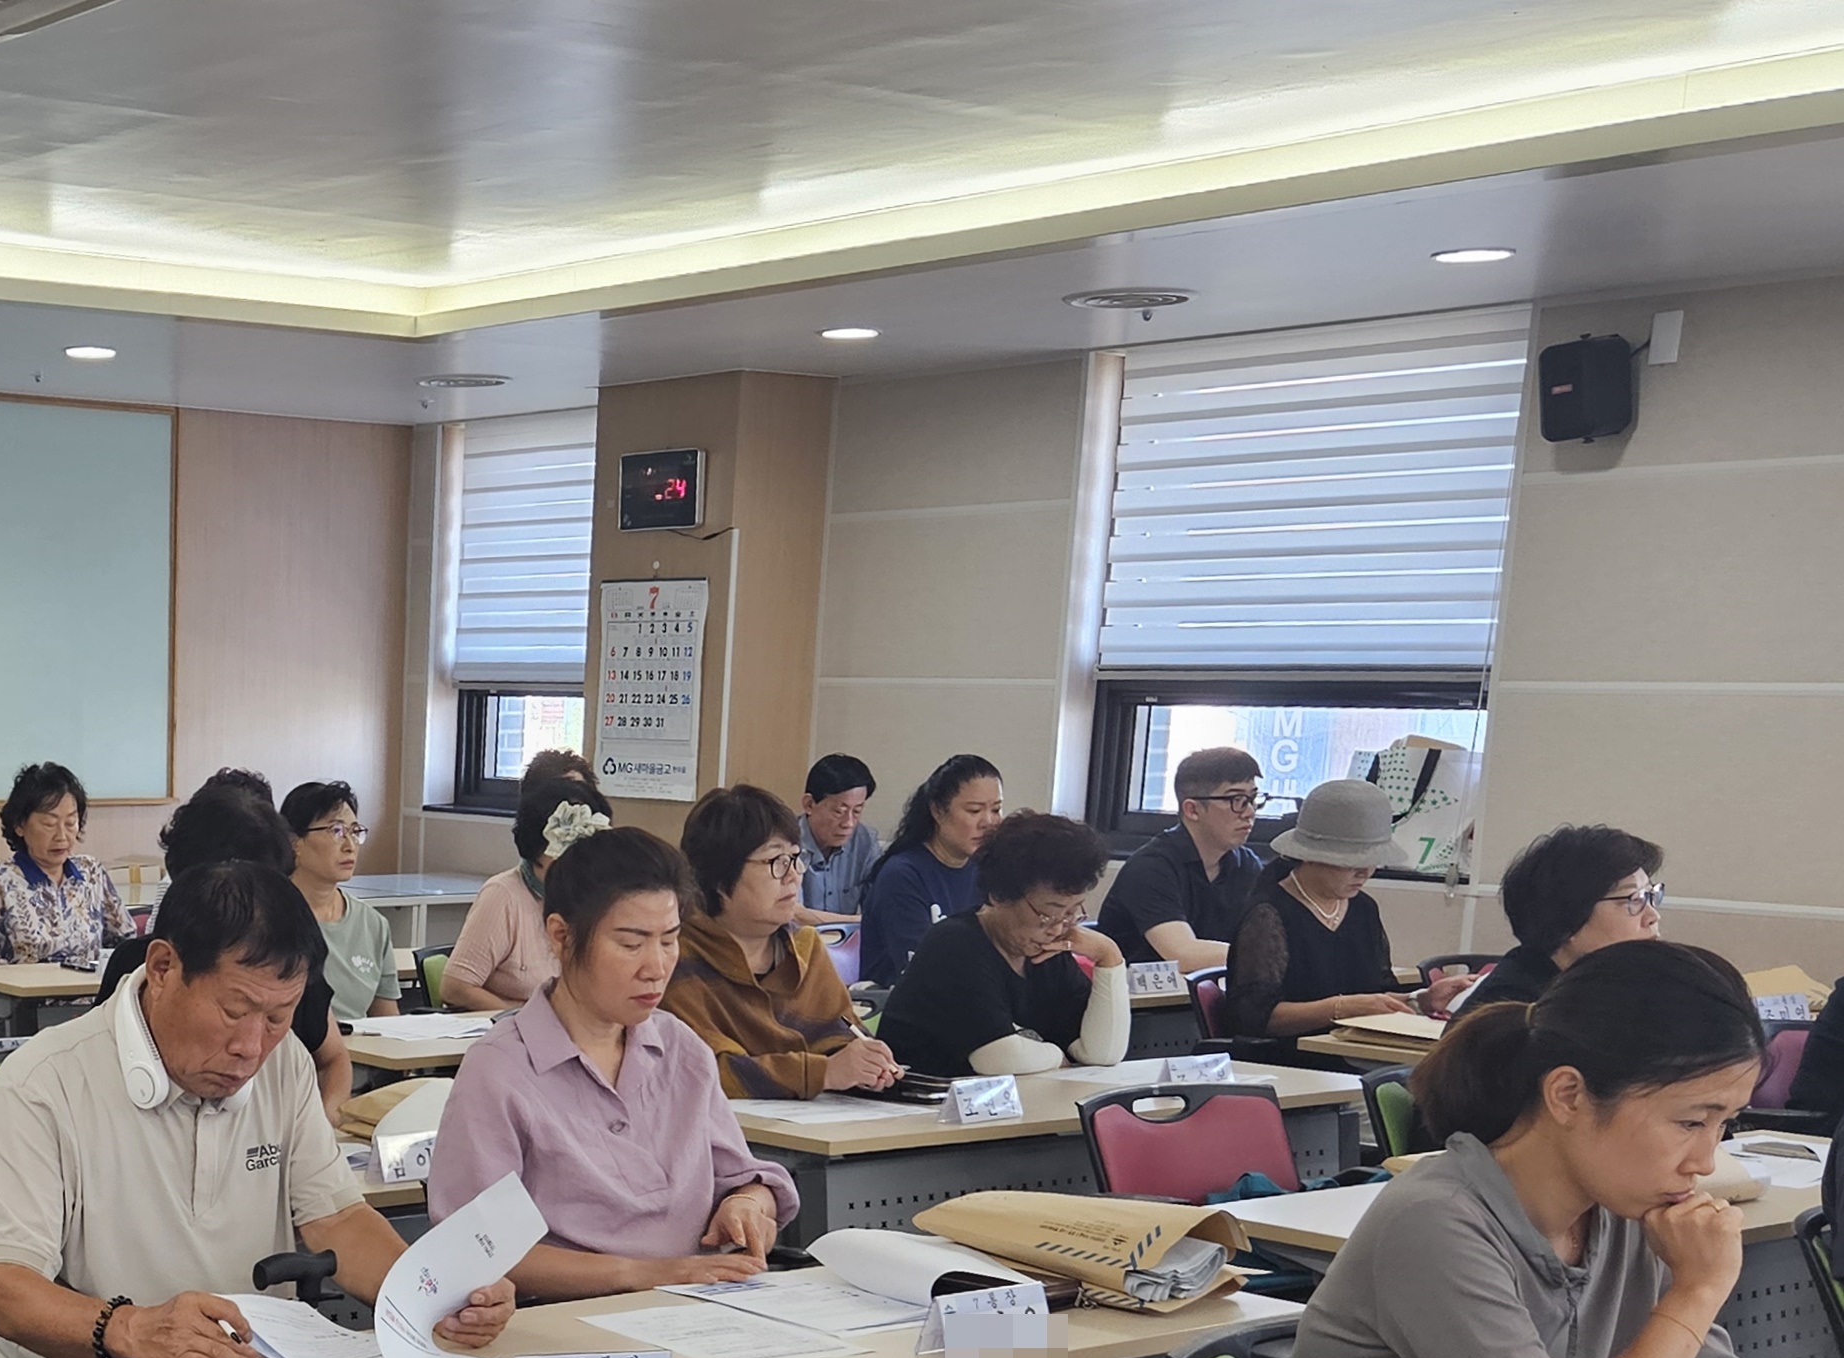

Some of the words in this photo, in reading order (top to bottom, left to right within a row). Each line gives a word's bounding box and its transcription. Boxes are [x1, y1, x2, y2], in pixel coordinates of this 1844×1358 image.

[649, 586, 660, 610] 7
[650, 623, 655, 634] 2
[662, 623, 667, 633] 3
[674, 623, 679, 633] 4
[687, 622, 693, 633] 5
[610, 647, 616, 657] 6
[623, 647, 629, 657] 7
[636, 647, 641, 657] 8
[648, 647, 654, 657] 9
[659, 647, 668, 657] 10
[672, 647, 680, 657] 11
[684, 646, 693, 657] 12
[607, 670, 616, 680] 13
[620, 670, 629, 680] 14
[633, 670, 642, 680] 15
[646, 670, 654, 680] 16
[657, 670, 667, 681] 17
[670, 670, 679, 681] 18
[683, 671, 691, 681] 19
[606, 693, 615, 703] 20
[619, 693, 628, 704] 21
[631, 693, 641, 704] 22
[644, 693, 653, 704] 23
[656, 694, 666, 704] 24
[669, 694, 678, 705] 25
[681, 694, 691, 705] 26
[605, 716, 614, 726] 27
[617, 716, 627, 727] 28
[630, 717, 640, 727] 29
[643, 717, 652, 727] 30
[655, 717, 664, 728] 31
[618, 762, 671, 775] MG새마을금고
